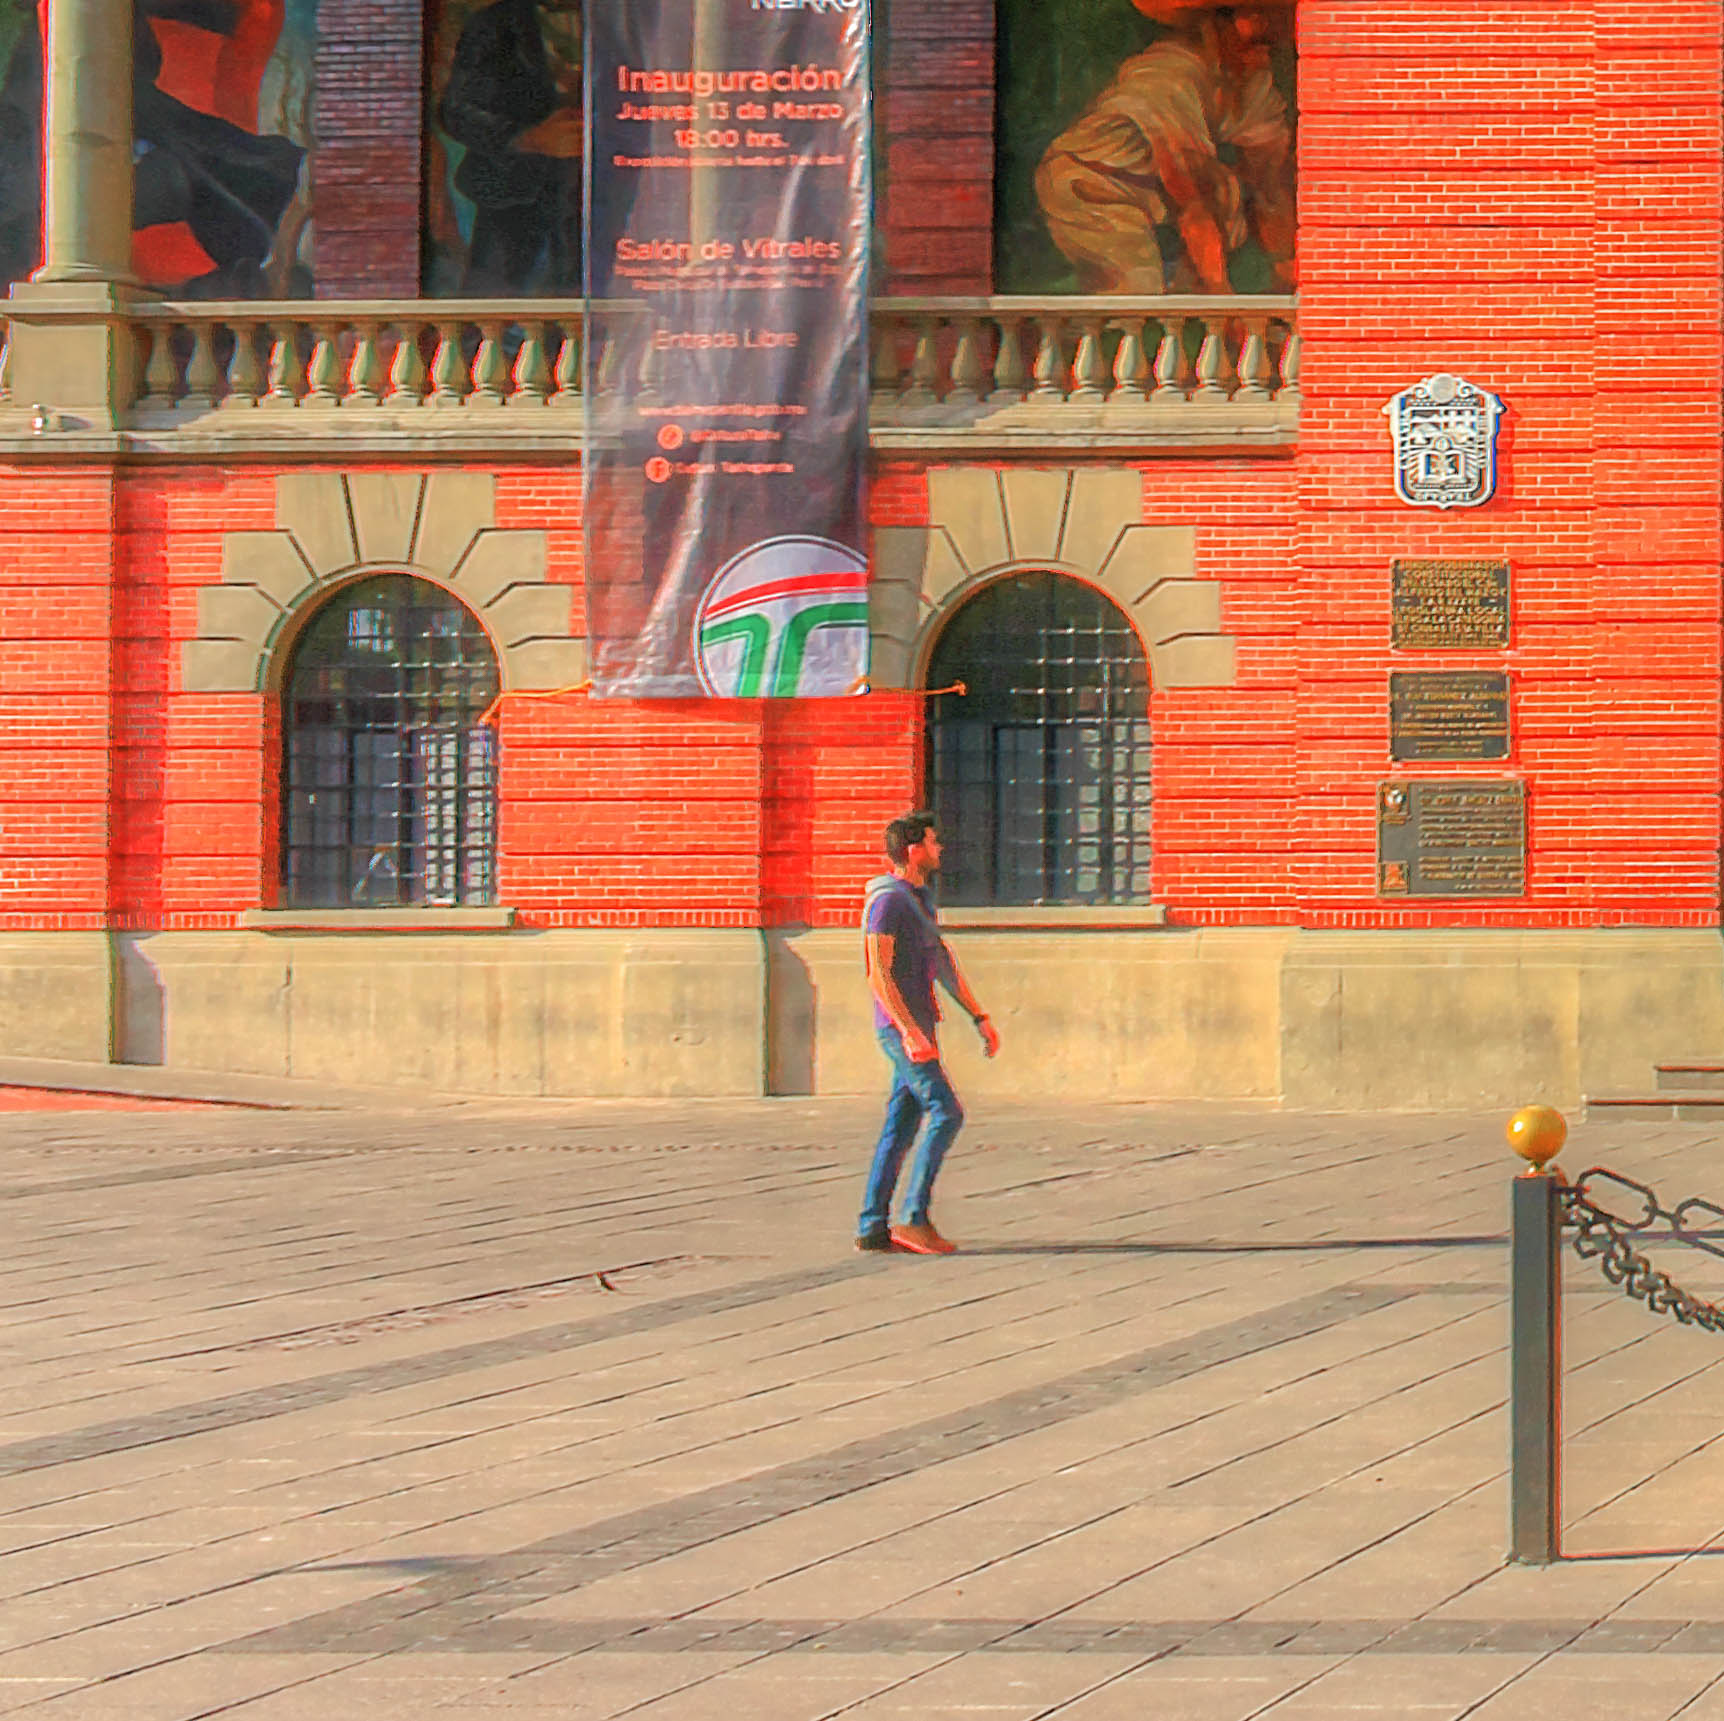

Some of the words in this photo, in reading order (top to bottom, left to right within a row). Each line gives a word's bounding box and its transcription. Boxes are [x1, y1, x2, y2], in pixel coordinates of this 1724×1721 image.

[616, 63, 842, 98] Inauguración
[616, 101, 699, 120] Jueves
[736, 101, 766, 120] de
[773, 101, 844, 120] Marzo
[745, 128, 790, 149] hrs.
[616, 234, 692, 261] Salón
[700, 237, 735, 259] de
[741, 235, 842, 259] Vitrales
[654, 329, 738, 350] Entrada
[743, 327, 800, 349] Libre
